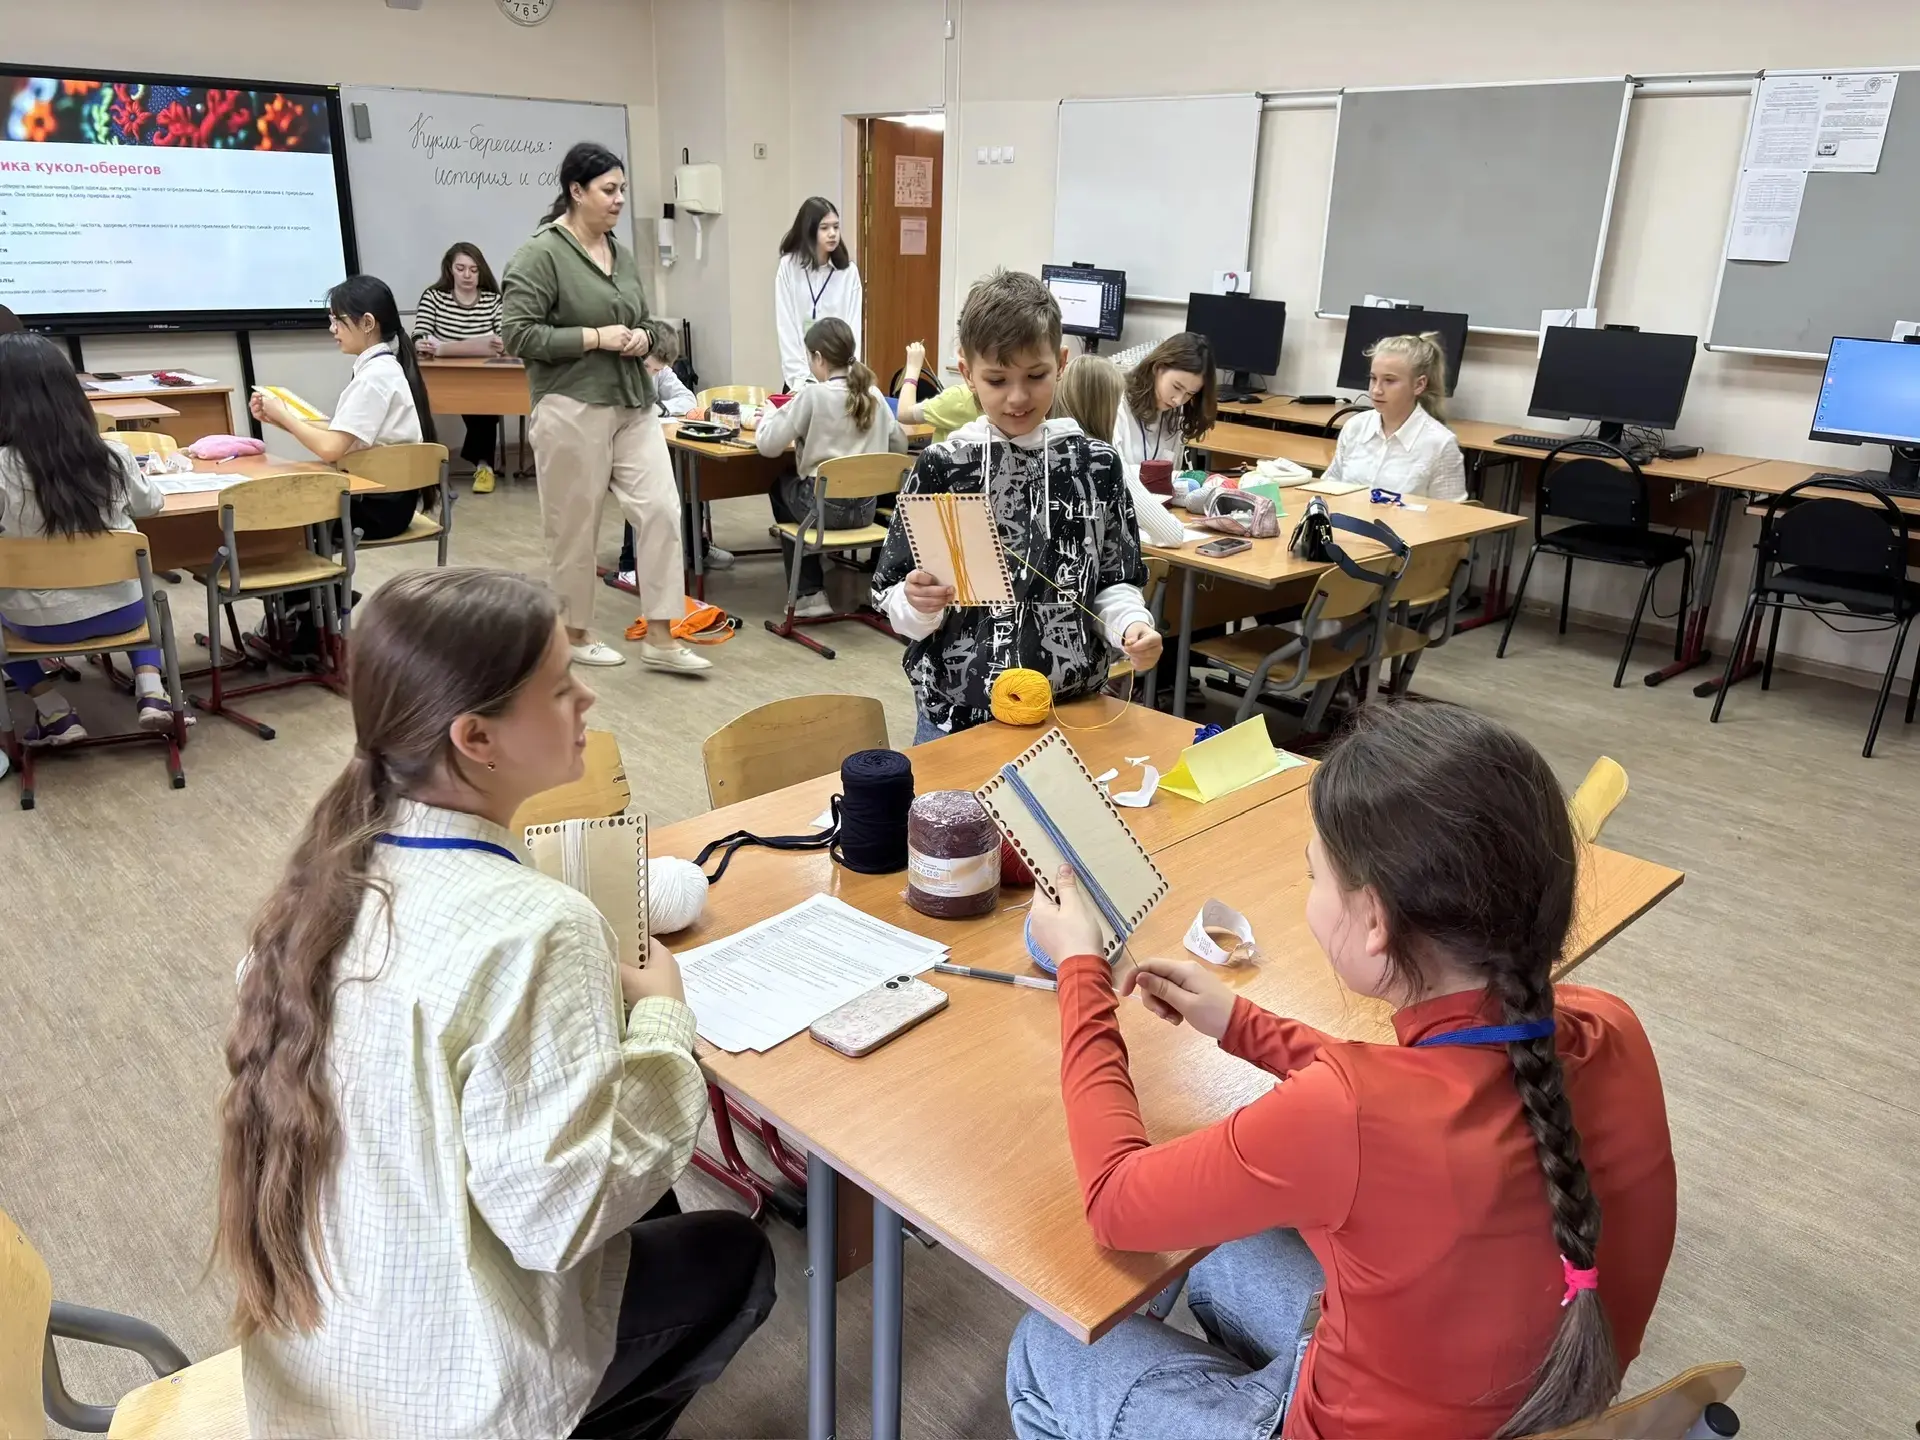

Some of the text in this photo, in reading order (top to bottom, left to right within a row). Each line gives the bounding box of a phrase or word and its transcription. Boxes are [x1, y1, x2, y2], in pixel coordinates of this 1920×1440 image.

[514, 3, 519, 11] 7
[523, 7, 529, 16] 6
[533, 5, 538, 13] 5
[408, 112, 553, 160] Кукла-берегиня:
[0, 161, 162, 177] ика кукол-оберегов
[434, 165, 513, 190] история
[519, 170, 530, 186] и
